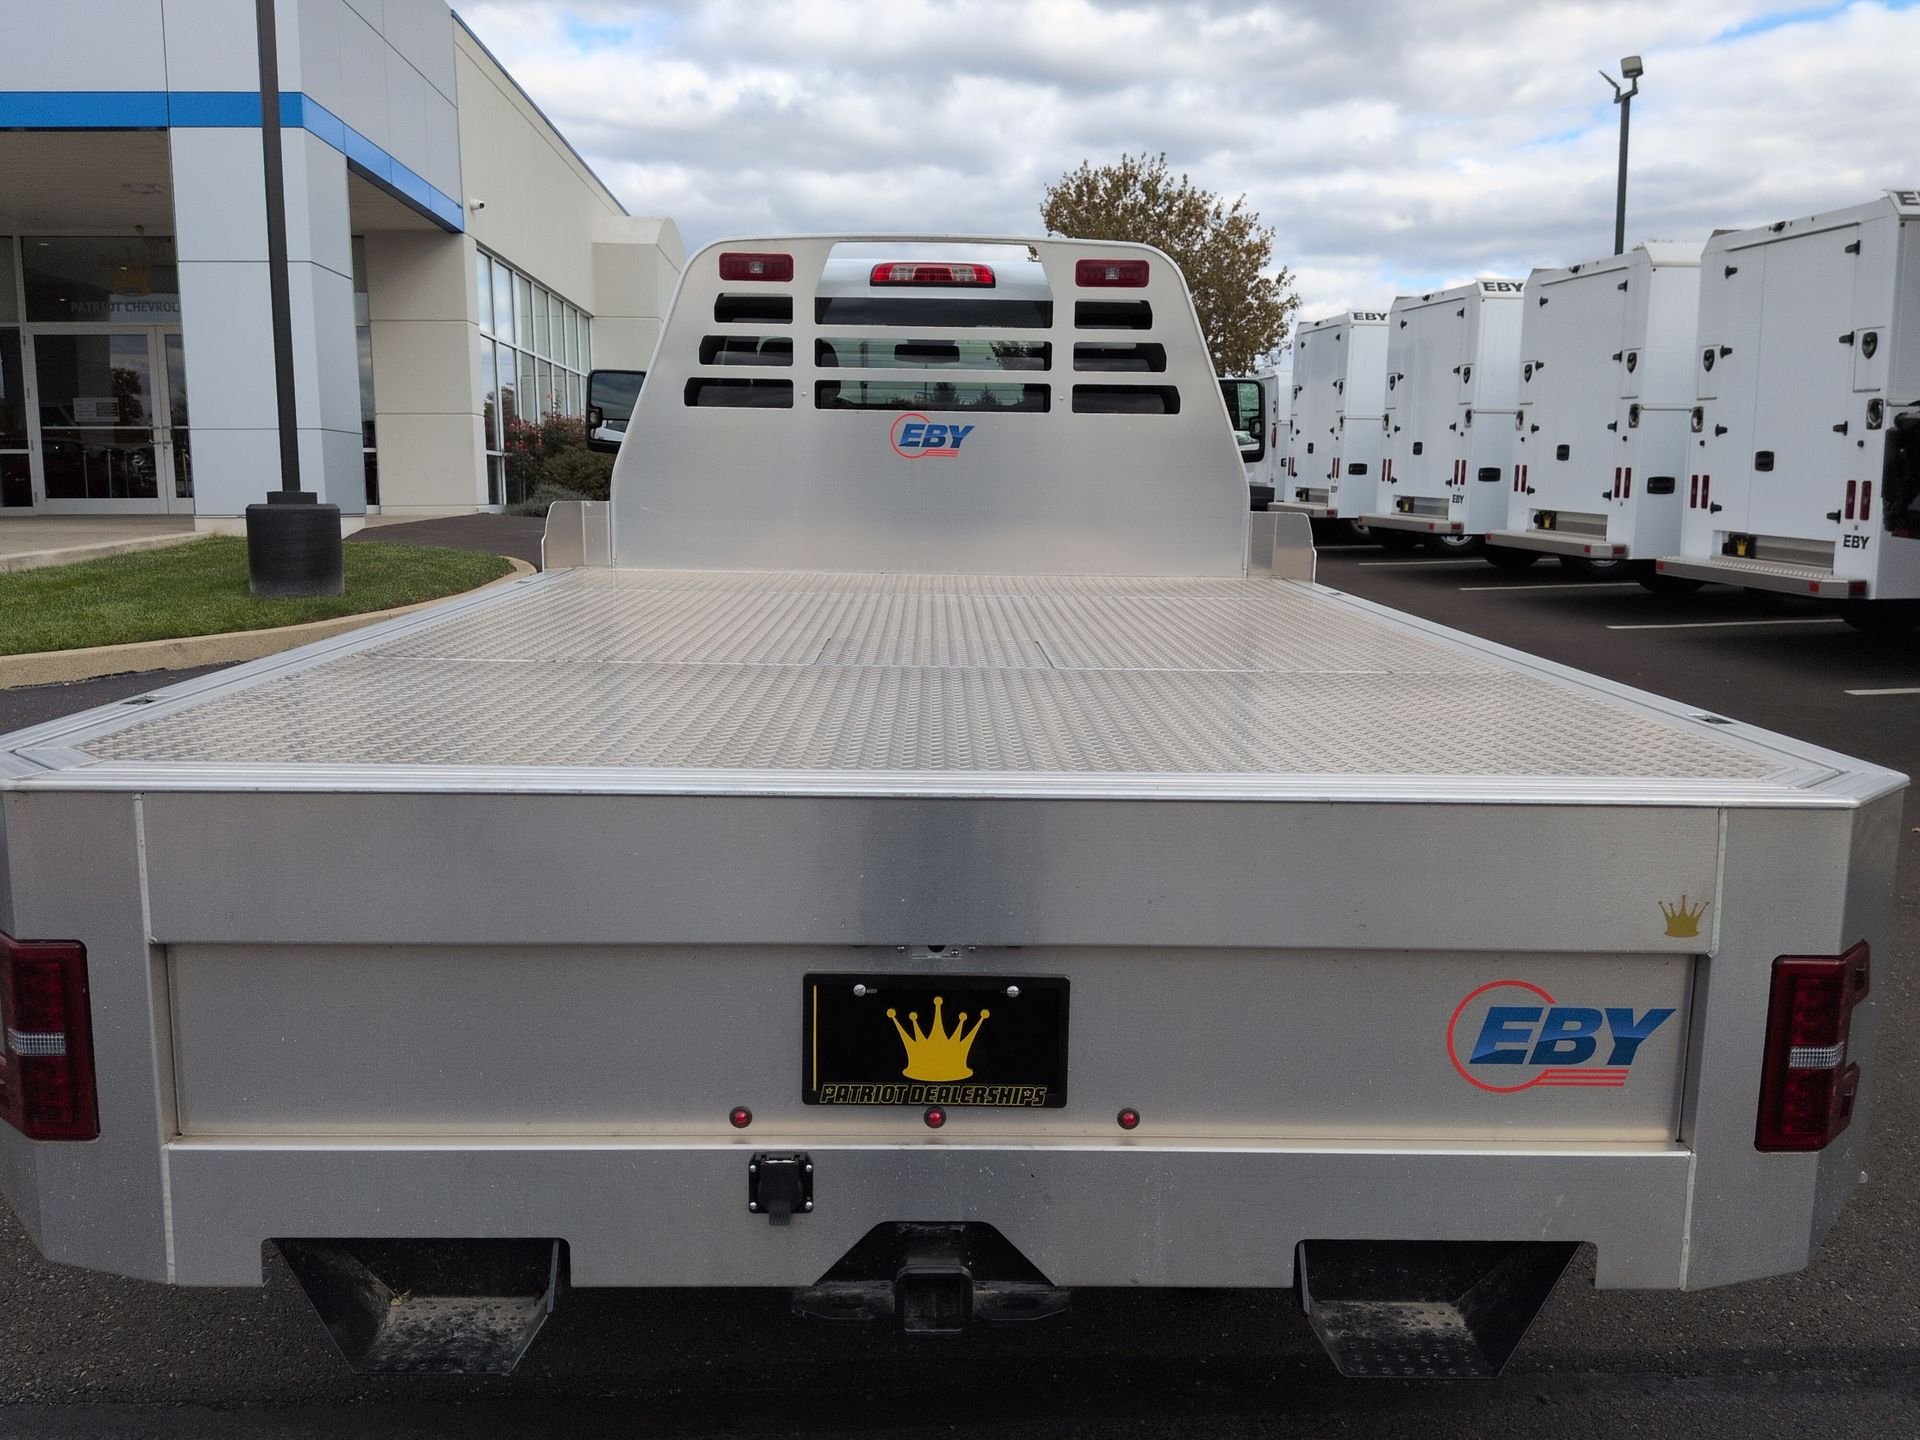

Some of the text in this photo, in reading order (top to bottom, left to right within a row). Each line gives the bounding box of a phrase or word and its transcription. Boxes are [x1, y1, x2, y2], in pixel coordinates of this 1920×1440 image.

[1482, 281, 1524, 293] EBY
[71, 302, 124, 313] PATRIOT
[1352, 312, 1388, 321] EBY
[899, 423, 976, 449] EBY
[1452, 494, 1465, 504] EBY
[1843, 534, 1870, 550] EBY
[1469, 1006, 1677, 1066] EBY
[820, 1082, 1047, 1106] PATRIOT DEALERSHIPS
